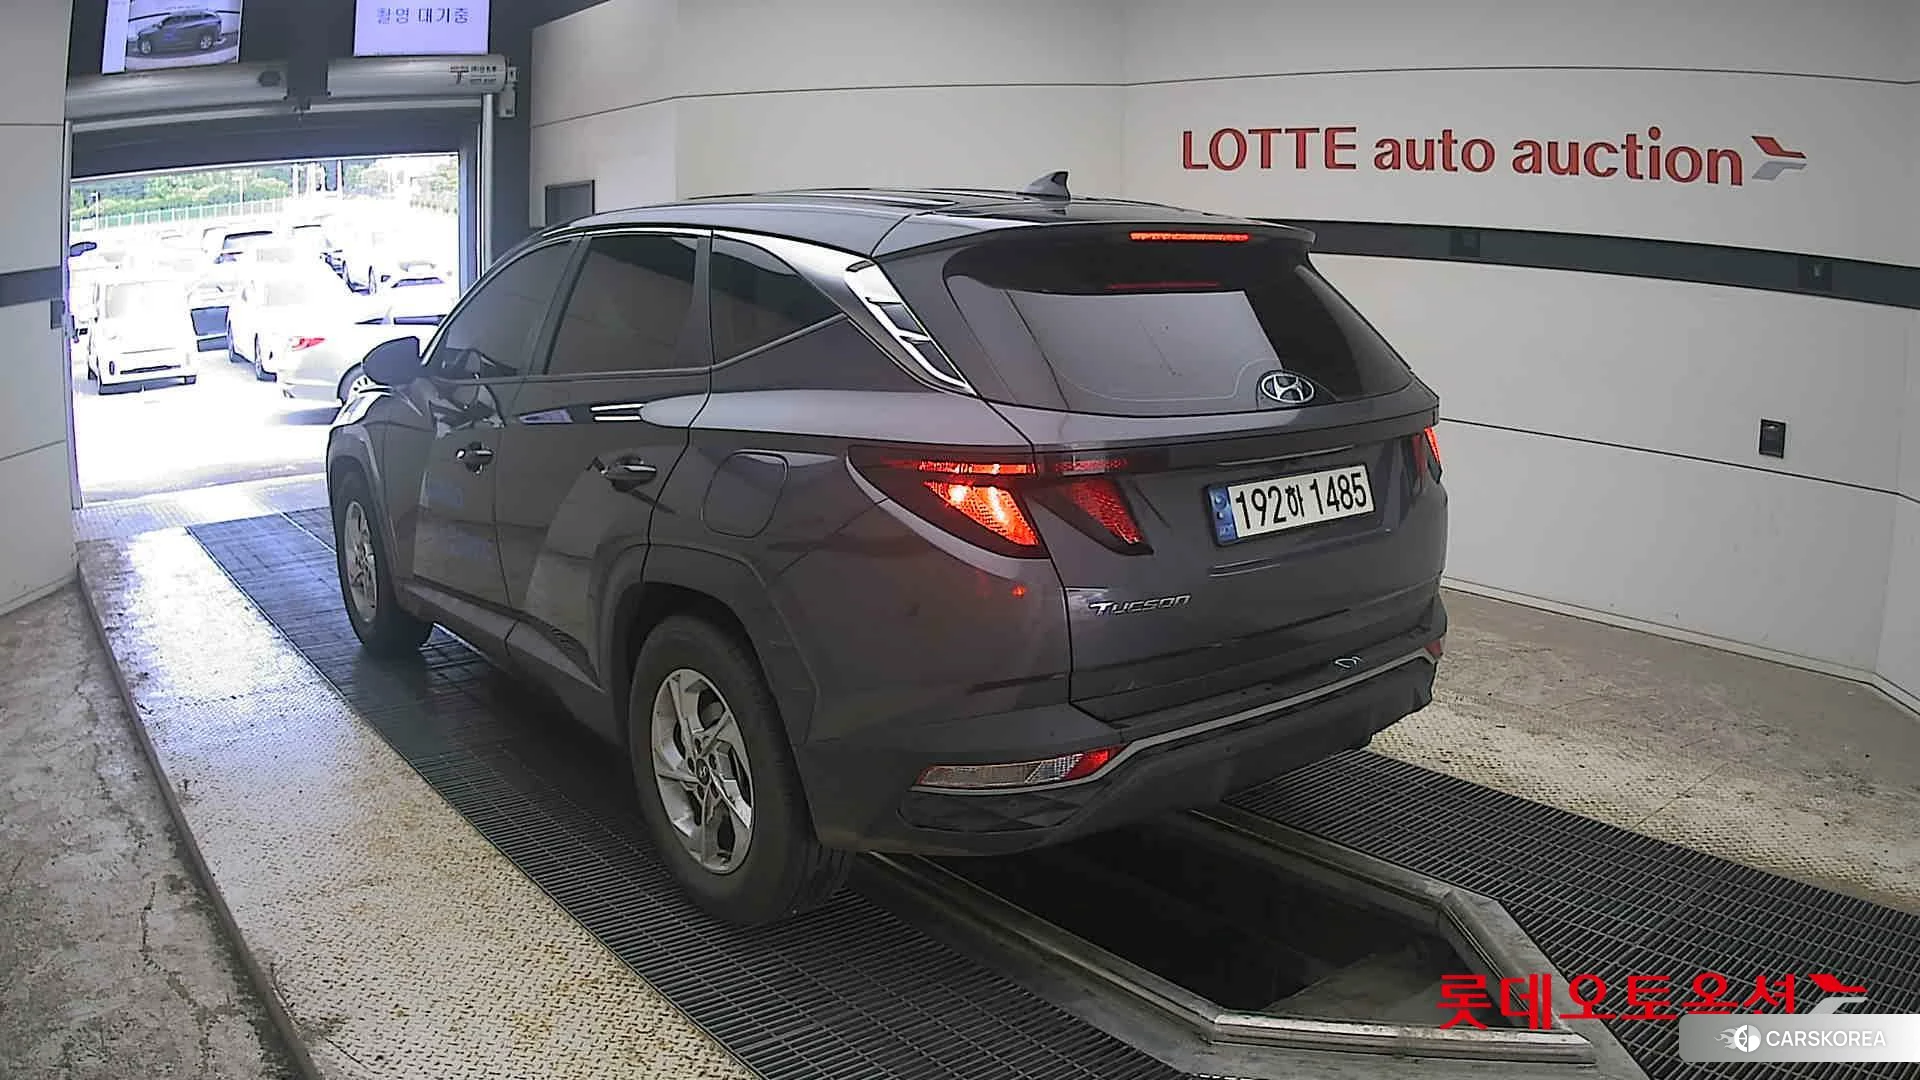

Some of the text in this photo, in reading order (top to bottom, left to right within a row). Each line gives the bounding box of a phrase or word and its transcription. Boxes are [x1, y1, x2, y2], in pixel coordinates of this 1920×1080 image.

[1183, 126, 1744, 185] LOTTE auto auction
[1310, 472, 1367, 515] 1485
